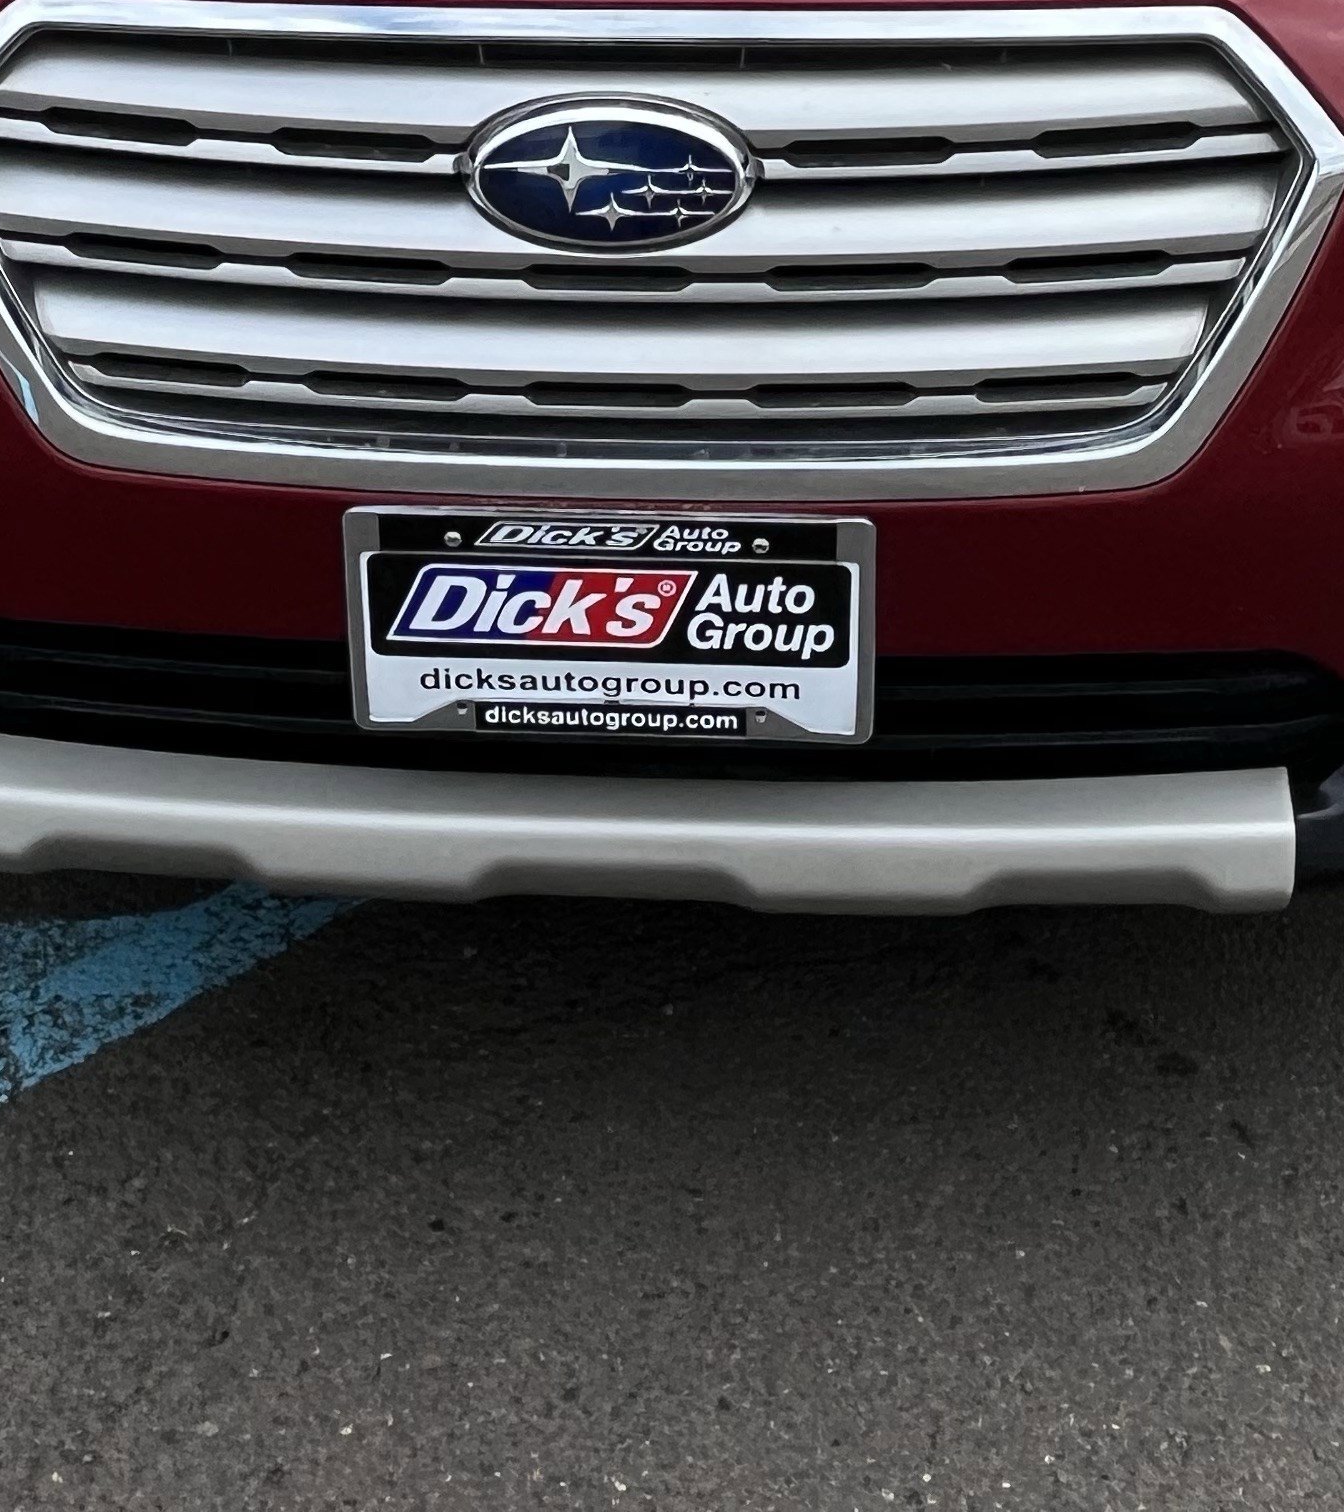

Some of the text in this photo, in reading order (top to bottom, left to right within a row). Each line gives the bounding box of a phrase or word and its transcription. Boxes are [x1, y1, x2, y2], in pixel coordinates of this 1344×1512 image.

[653, 537, 742, 555] Group
[660, 525, 729, 540] Auto
[694, 573, 816, 615] Auto
[686, 612, 836, 661] Group
[419, 668, 801, 700] dicksautogroup.com
[484, 705, 739, 732] dicksautogroup.com
